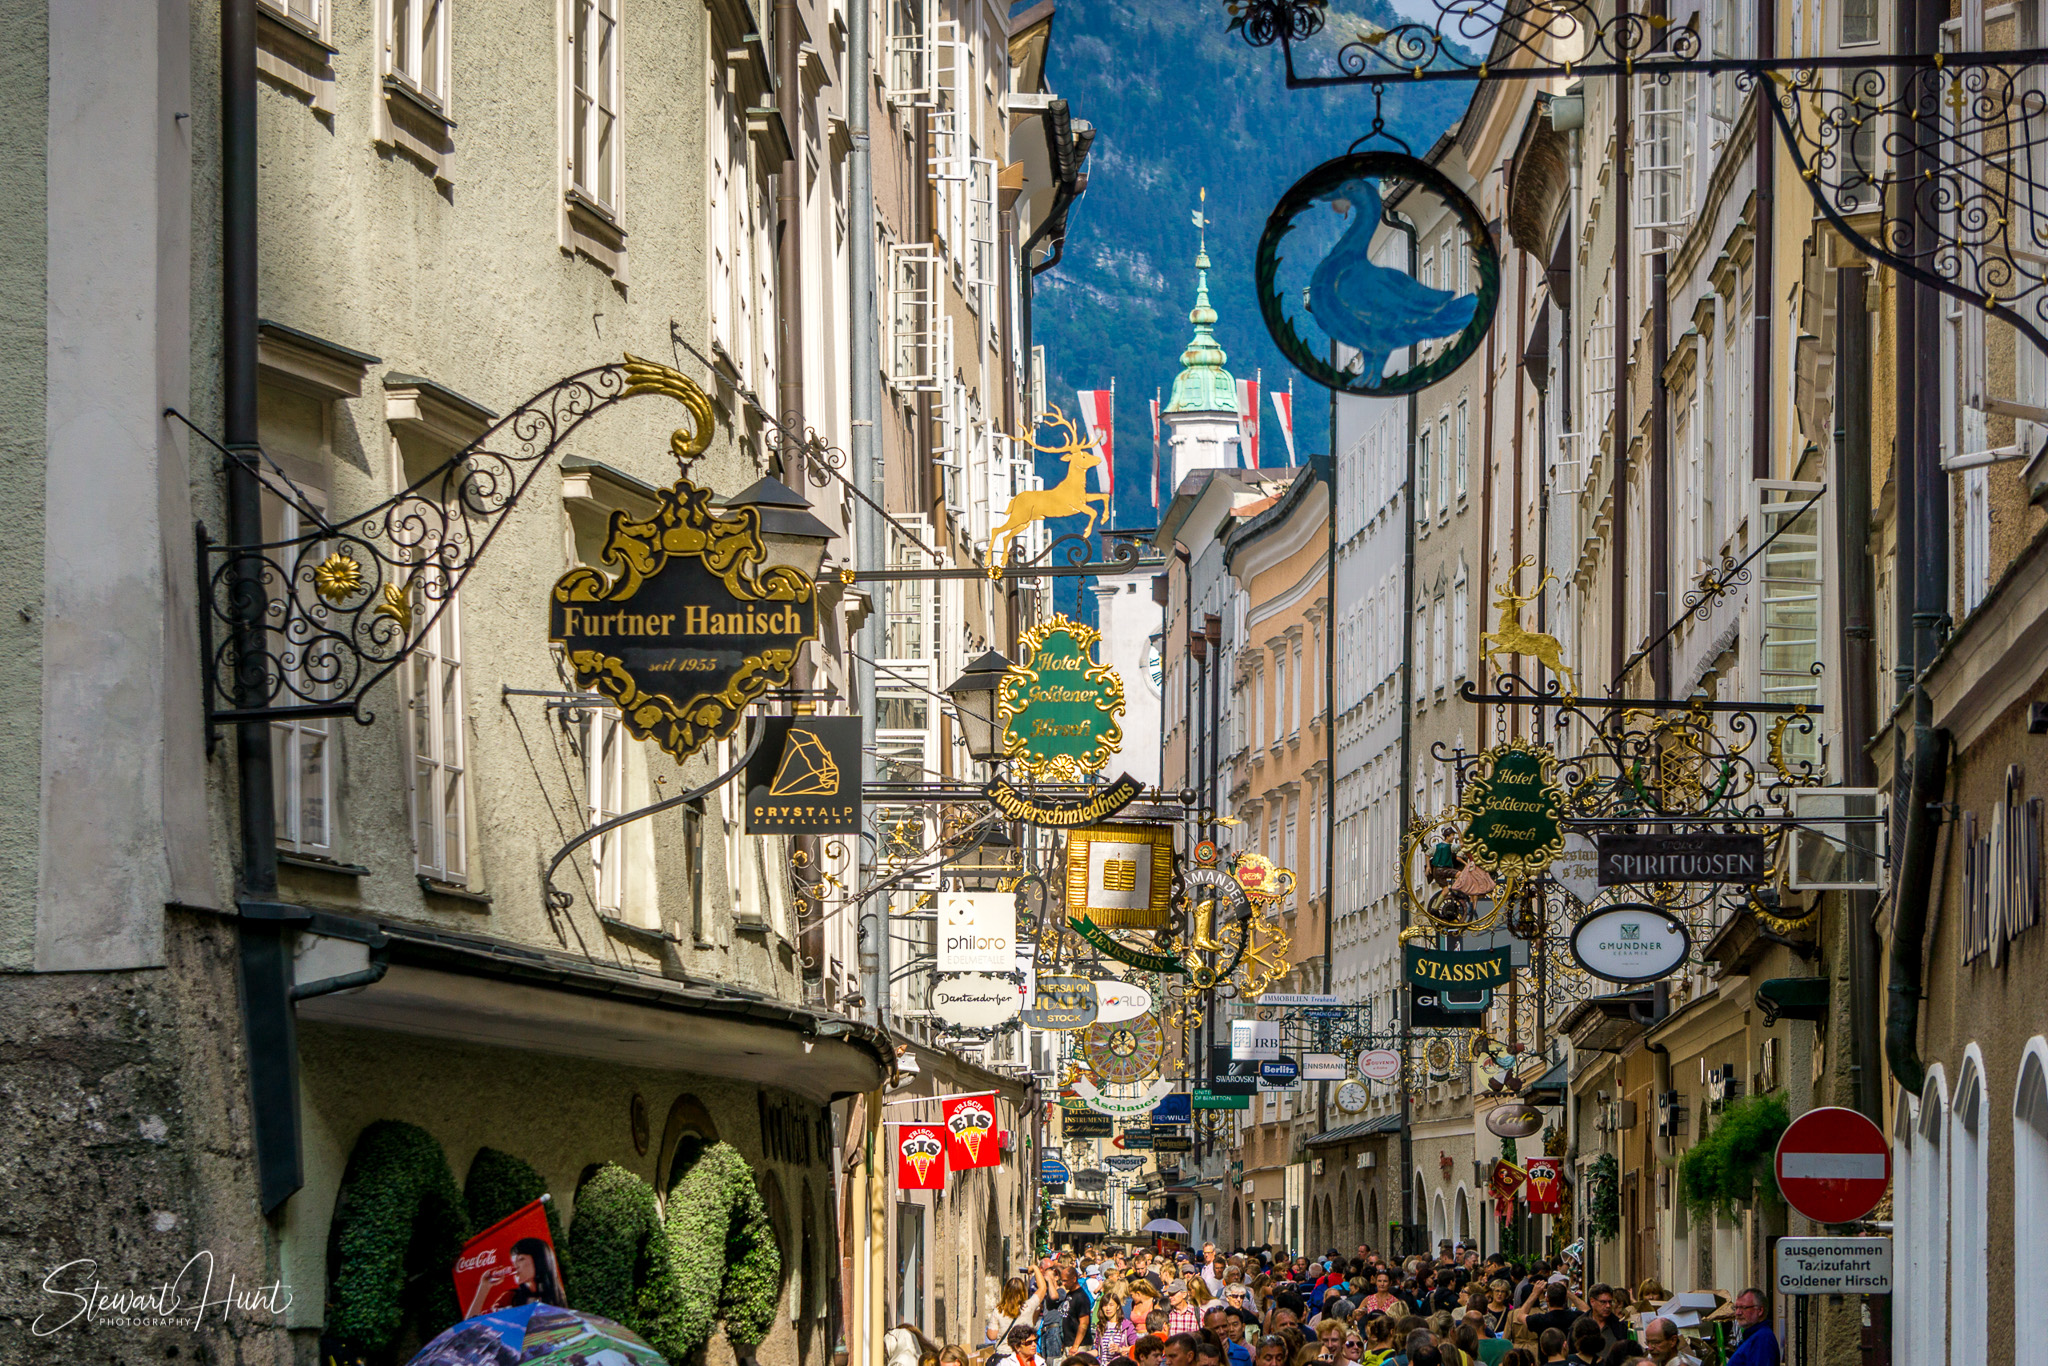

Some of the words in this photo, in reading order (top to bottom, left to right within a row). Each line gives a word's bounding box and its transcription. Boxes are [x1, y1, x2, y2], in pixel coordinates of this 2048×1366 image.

[562, 606, 676, 637] Furtner
[683, 604, 803, 637] Hanisch
[648, 656, 675, 672] seit
[678, 656, 718, 672] 1955
[1037, 652, 1085, 672] Hotel
[1028, 685, 1099, 703] Goldener
[1029, 717, 1092, 737] Hirsch
[1496, 768, 1538, 785] Hotel
[987, 780, 1136, 825] Kupferschmiedhaus
[1485, 795, 1545, 813] Goldener
[754, 806, 853, 817] CRYSTALP
[1488, 823, 1537, 841] Hirsch
[1560, 850, 1599, 863] estau
[1609, 853, 1755, 875] SPIRITUOSEN
[1172, 870, 1246, 907] AMANDER
[947, 935, 1006, 953] philoro
[1086, 928, 1165, 970] DENKSTEIN
[1599, 942, 1662, 950] GMUNDNER
[1415, 957, 1502, 982] STASSNY
[1036, 984, 1090, 993] SIERSALON
[938, 993, 1013, 1006] Dantendorfer
[1035, 996, 1094, 1011] IGARO
[1047, 1014, 1082, 1022] STOCK
[1255, 1038, 1278, 1048] IRB
[1264, 1065, 1295, 1074] Berlitz
[1215, 1075, 1255, 1083] SWAROVSKI
[953, 1100, 984, 1114] FRISCH
[1090, 1095, 1158, 1112] Aschauer
[949, 1114, 991, 1133] EIS
[908, 1128, 936, 1139] FRISCH
[902, 1140, 940, 1156] EIS
[1529, 1168, 1555, 1180] EIS
[1784, 1246, 1883, 1257] ausgenommen
[1796, 1259, 1871, 1271] Taxizufahrt
[1780, 1274, 1842, 1287] Goldener
[1845, 1274, 1888, 1287] Hirsch
